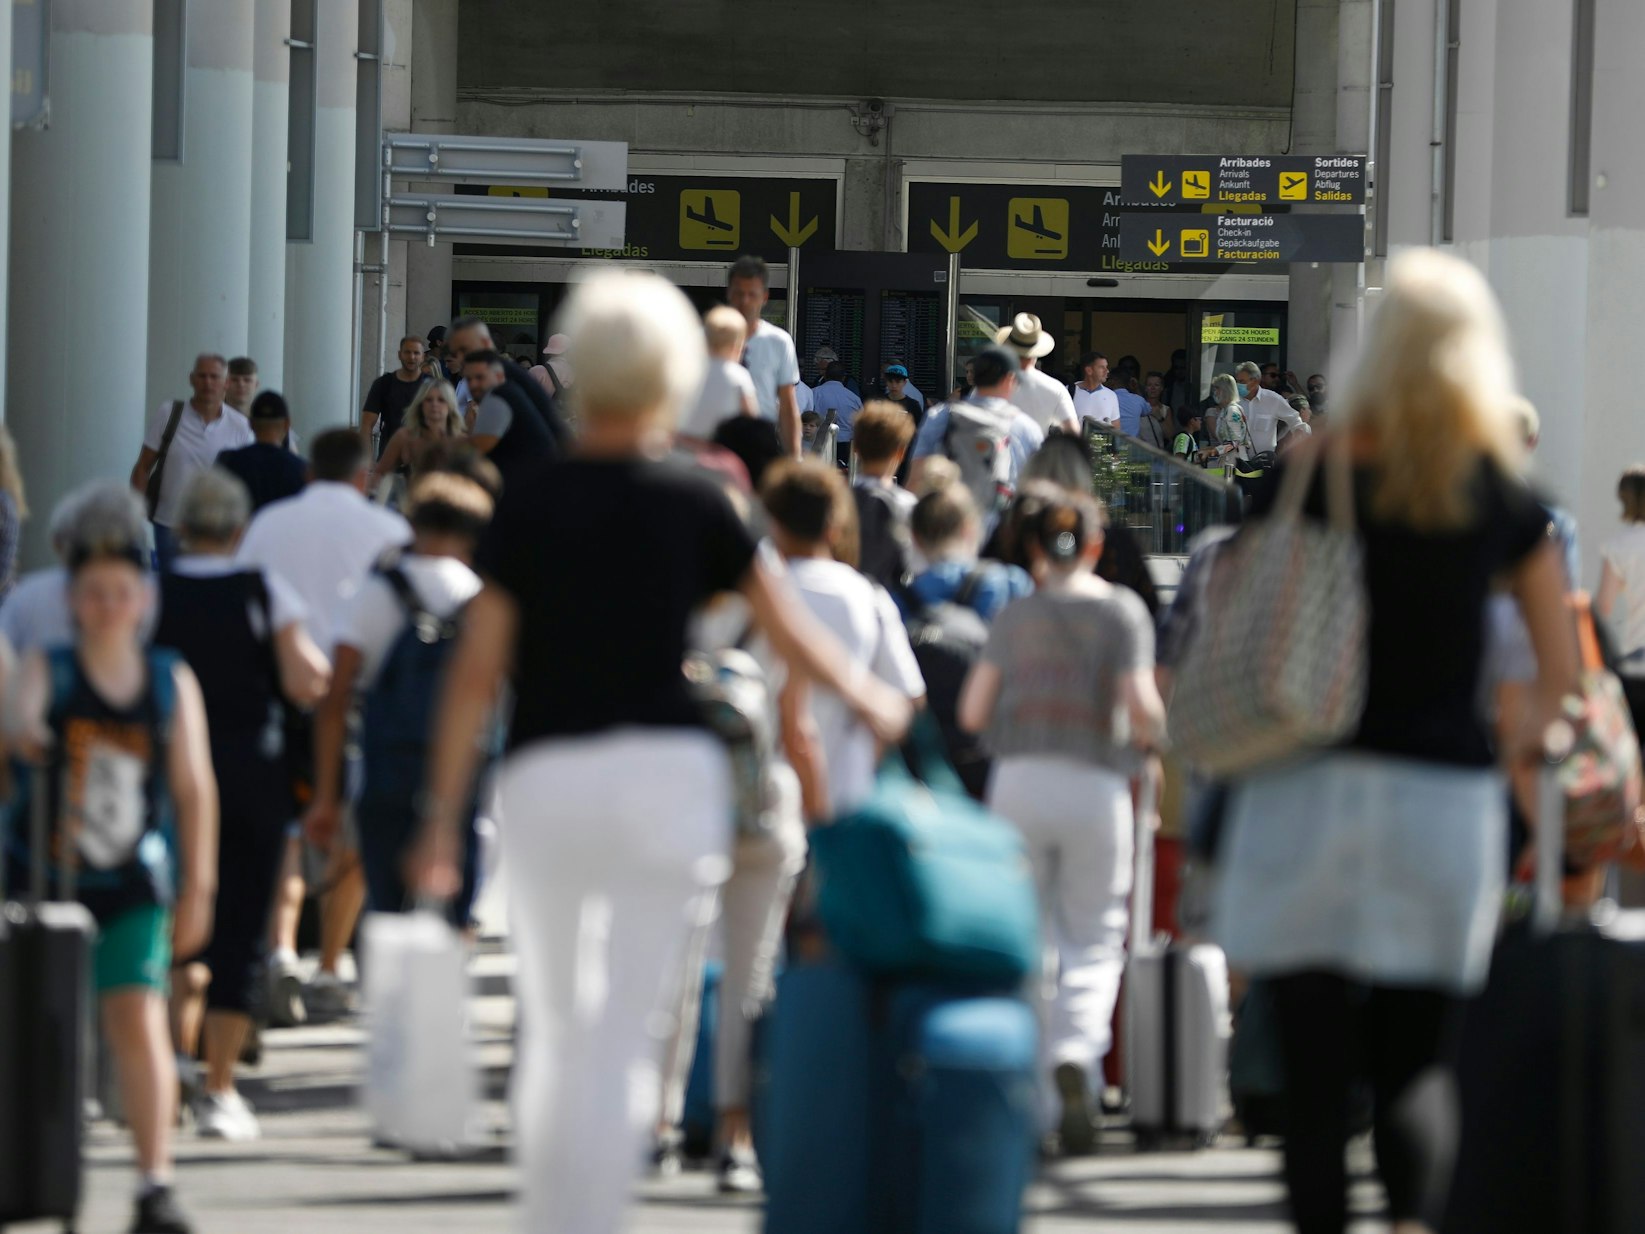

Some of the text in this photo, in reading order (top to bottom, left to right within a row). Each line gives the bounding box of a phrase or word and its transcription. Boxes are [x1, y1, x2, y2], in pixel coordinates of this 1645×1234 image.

[1220, 157, 1271, 168] Arribades
[1315, 157, 1359, 168] Sortides
[1219, 169, 1250, 178] Arrivals
[1314, 169, 1360, 180] Departures
[1219, 180, 1251, 189] Ankunft
[1315, 180, 1341, 190] Abflug
[1219, 190, 1267, 202] Llegadas
[1315, 191, 1352, 201] Salidas
[1217, 216, 1274, 226] Facturació
[1217, 228, 1252, 237] Check-in
[1217, 238, 1280, 249] Gepäckaufgabe
[1217, 249, 1280, 259] Facturación
